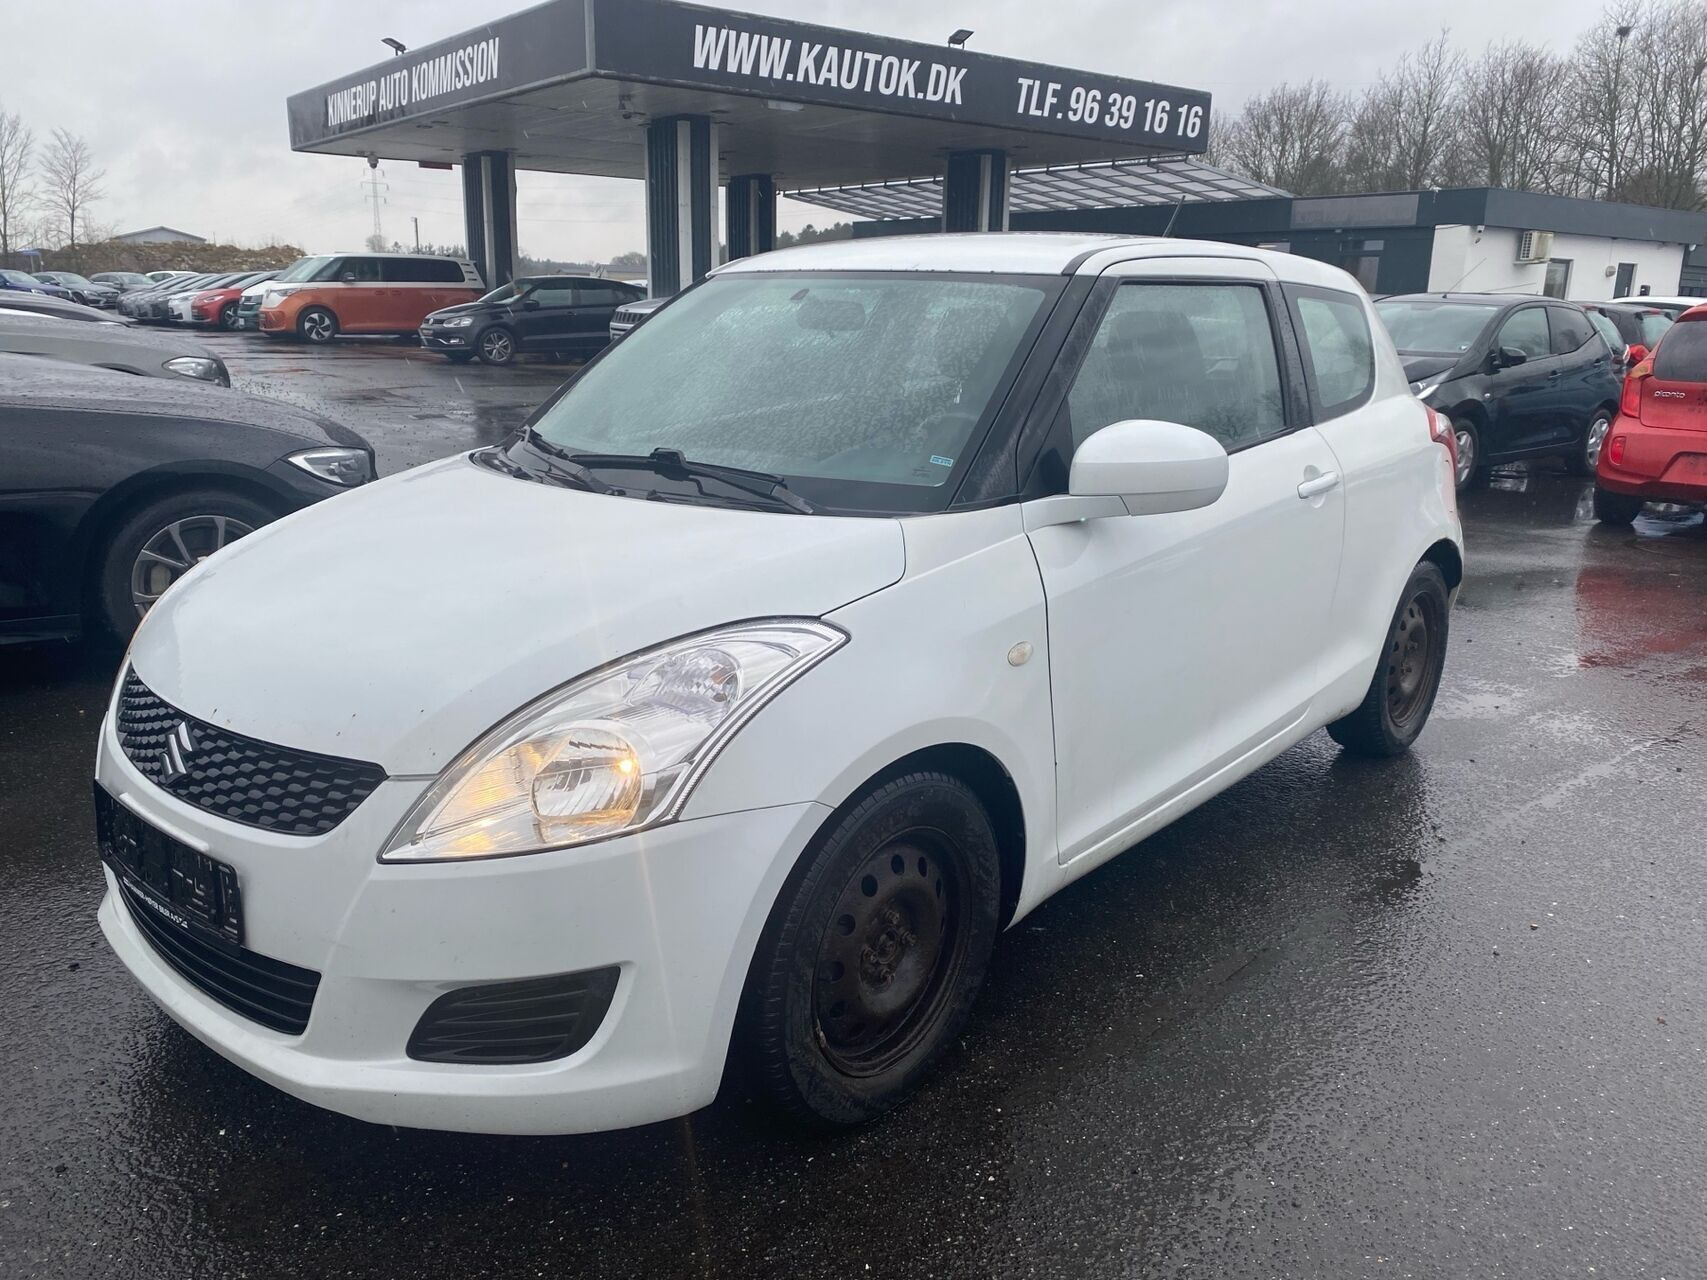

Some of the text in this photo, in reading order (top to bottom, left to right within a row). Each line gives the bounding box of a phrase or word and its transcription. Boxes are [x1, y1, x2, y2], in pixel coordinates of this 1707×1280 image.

[328, 37, 500, 127] KINNERUP AUTO KOMMISSION
[693, 24, 968, 105] WWW.KAUTOK.DK
[1017, 77, 1203, 138] TLF. 96 39 16 16
